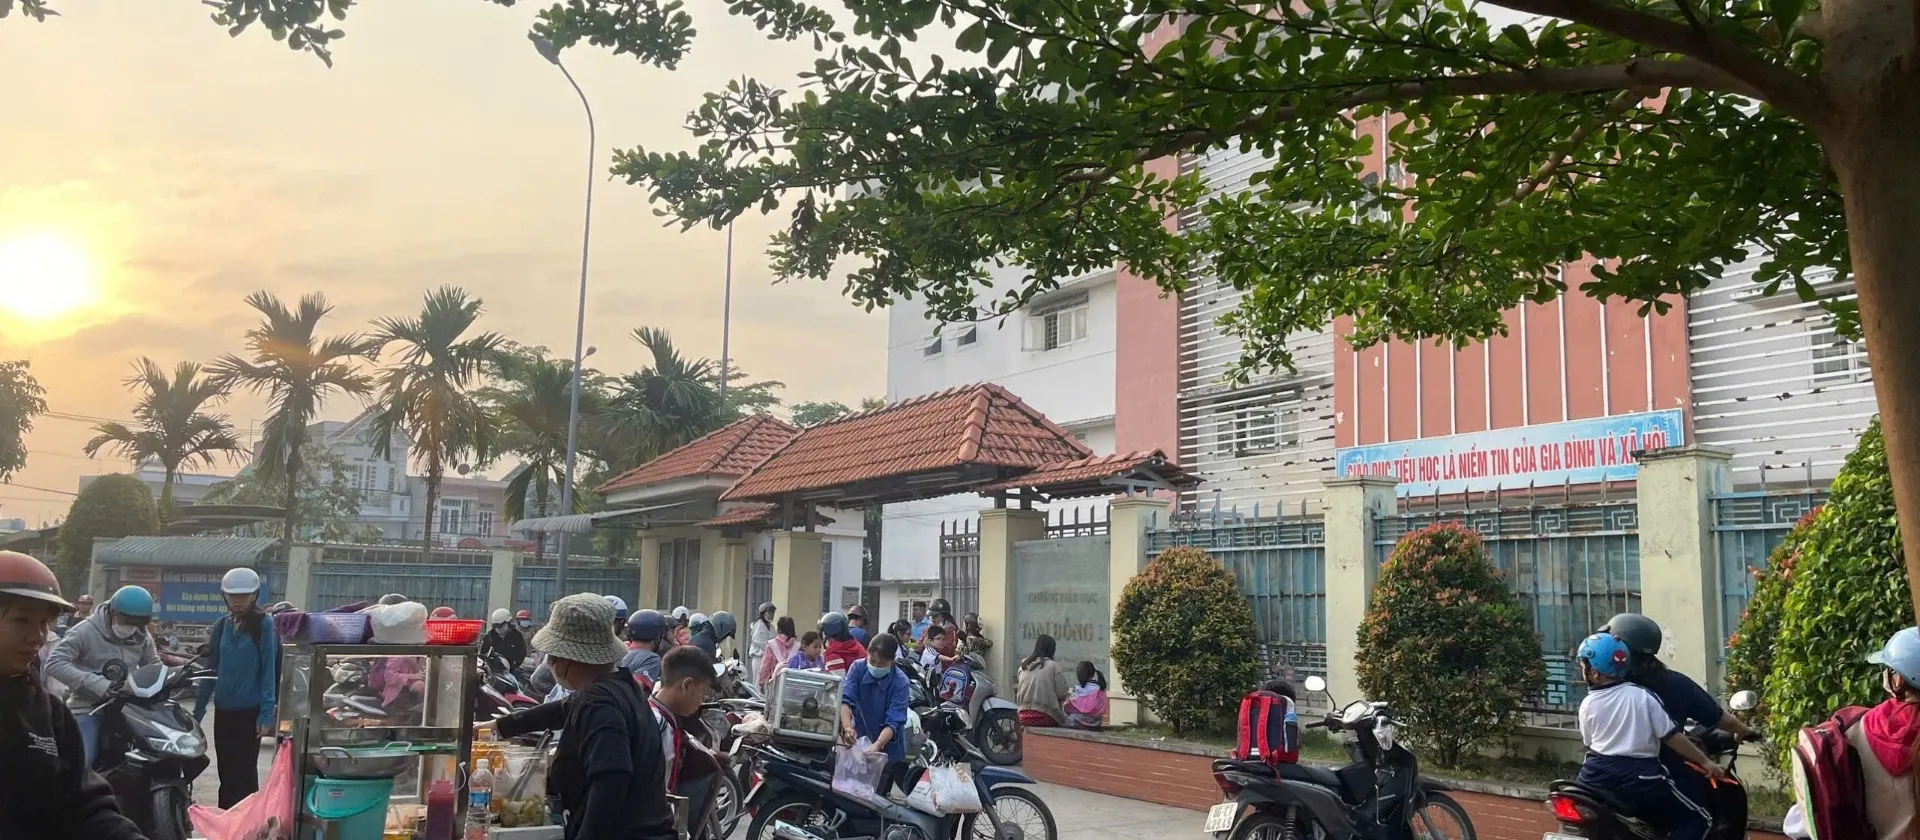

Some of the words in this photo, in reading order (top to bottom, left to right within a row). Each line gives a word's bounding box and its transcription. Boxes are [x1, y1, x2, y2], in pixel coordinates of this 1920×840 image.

[1394, 448, 1415, 484] TIỂU
[1419, 456, 1439, 487] HỌC
[1443, 449, 1456, 480] LÀ
[1459, 443, 1487, 479] NIỀM
[1491, 448, 1509, 475] TIN
[1513, 437, 1537, 474] CỦA
[1540, 443, 1561, 471] GIA
[1564, 435, 1596, 469] ĐÌNH
[1599, 431, 1616, 466] VÀ
[1620, 429, 1638, 464] XÃ
